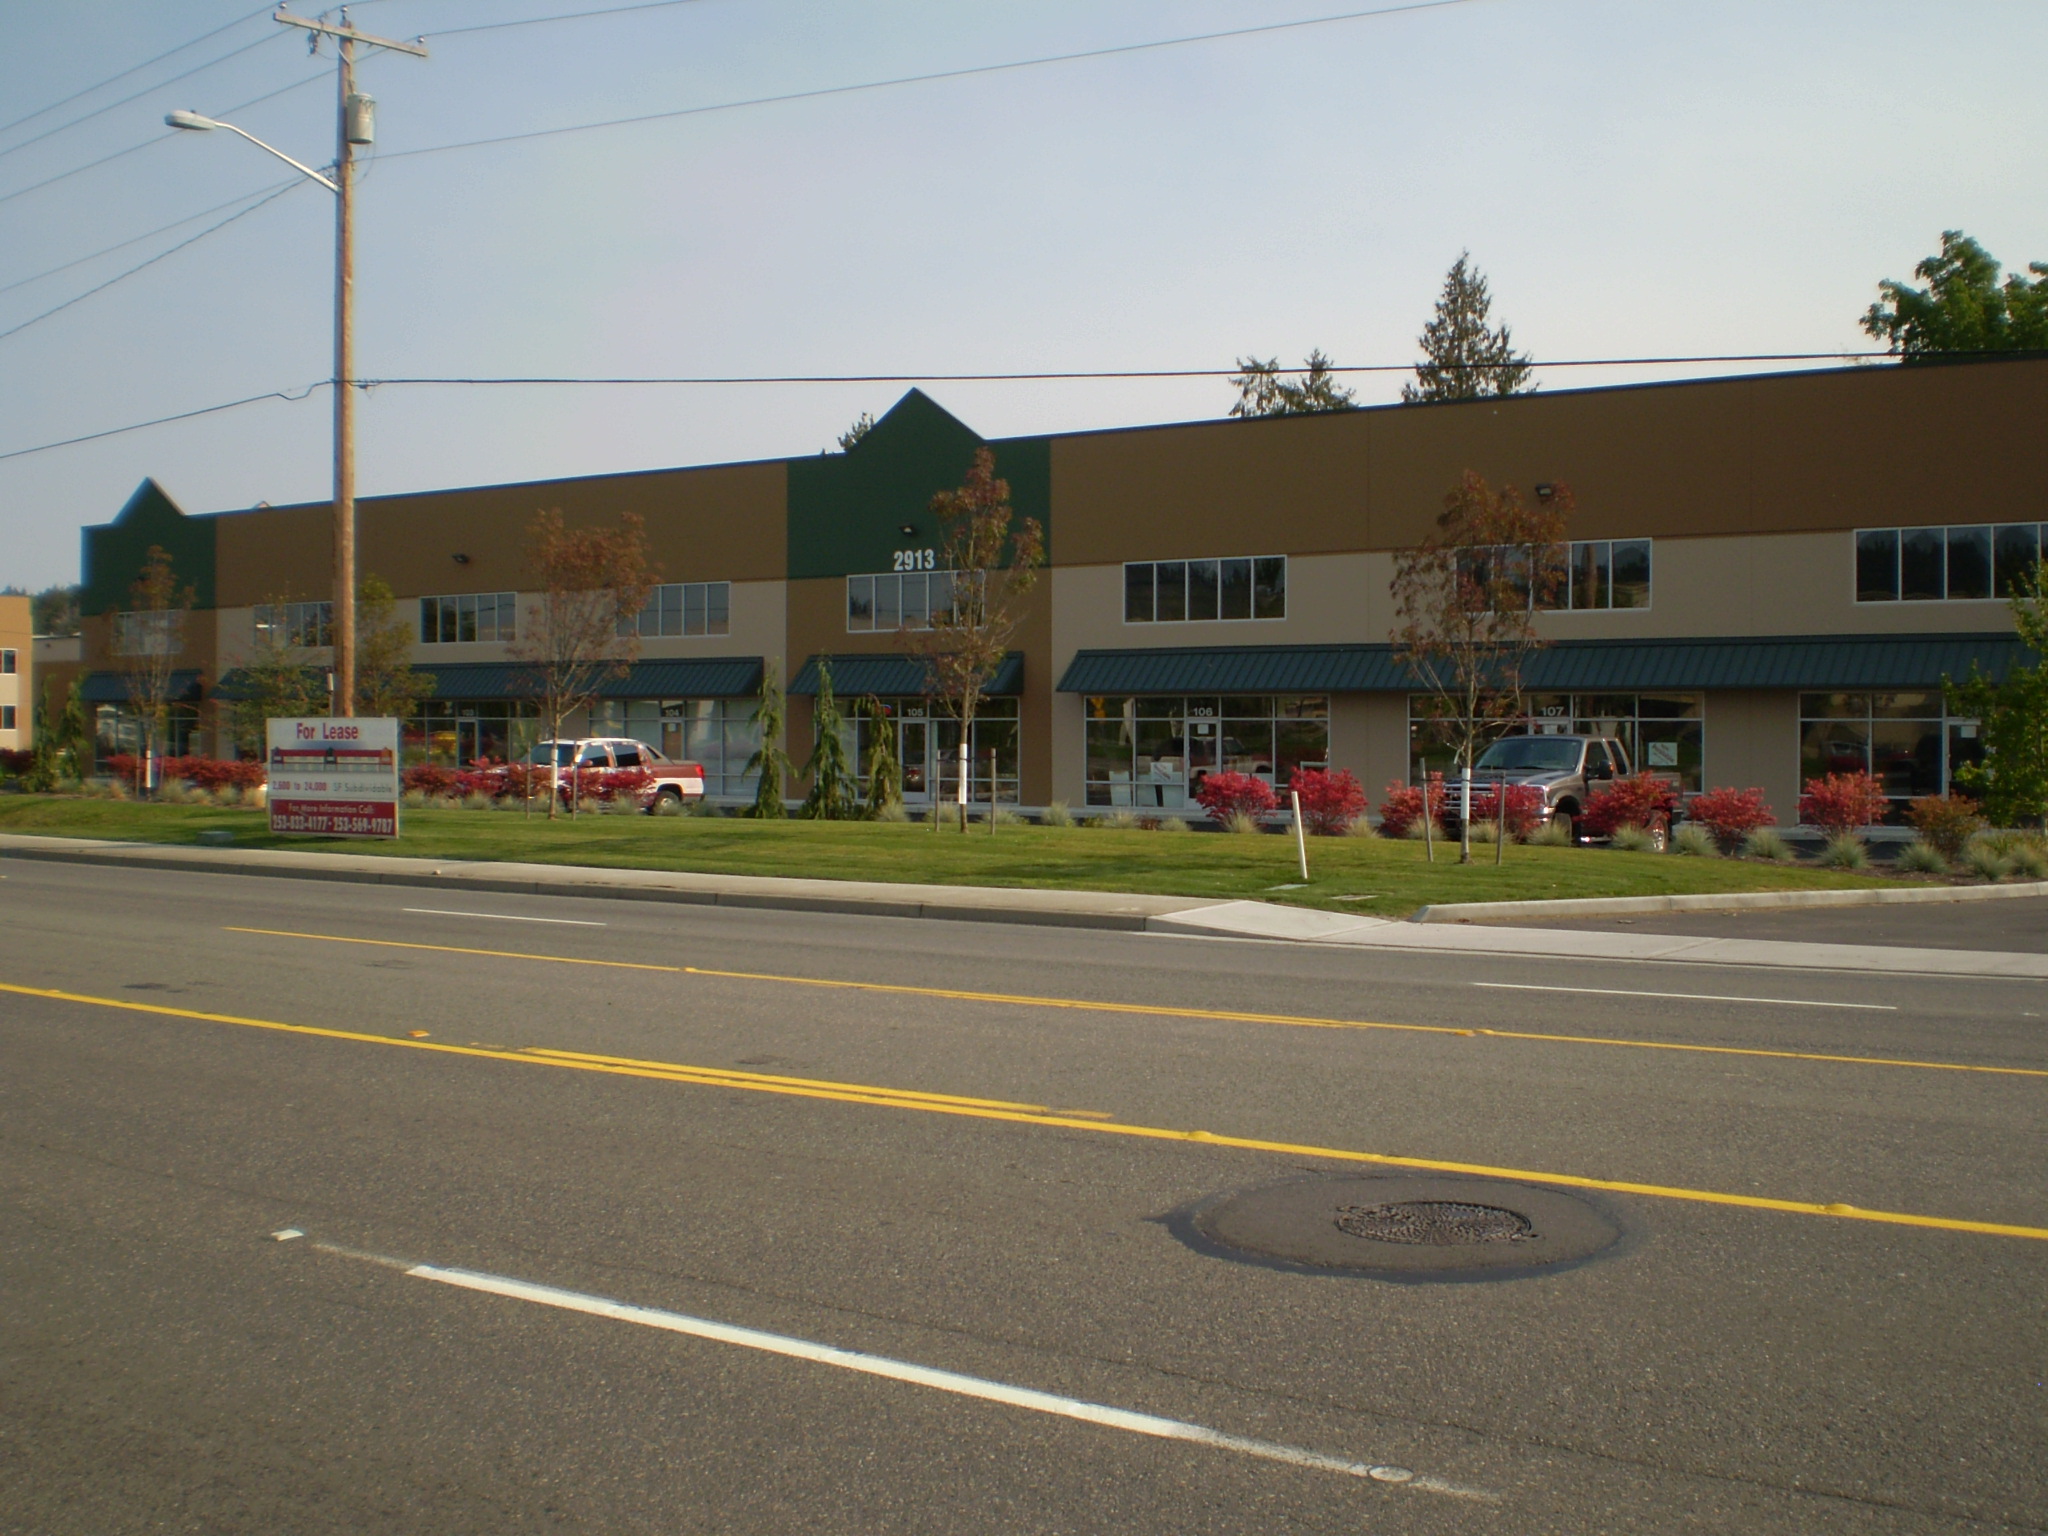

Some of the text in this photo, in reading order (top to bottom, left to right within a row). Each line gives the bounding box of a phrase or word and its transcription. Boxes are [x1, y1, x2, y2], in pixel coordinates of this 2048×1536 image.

[893, 549, 935, 571] 2913
[907, 708, 923, 717] 105
[1193, 707, 1213, 716] 106
[1541, 706, 1564, 716] 107
[296, 722, 359, 739] For Lease
[319, 804, 357, 814] Information
